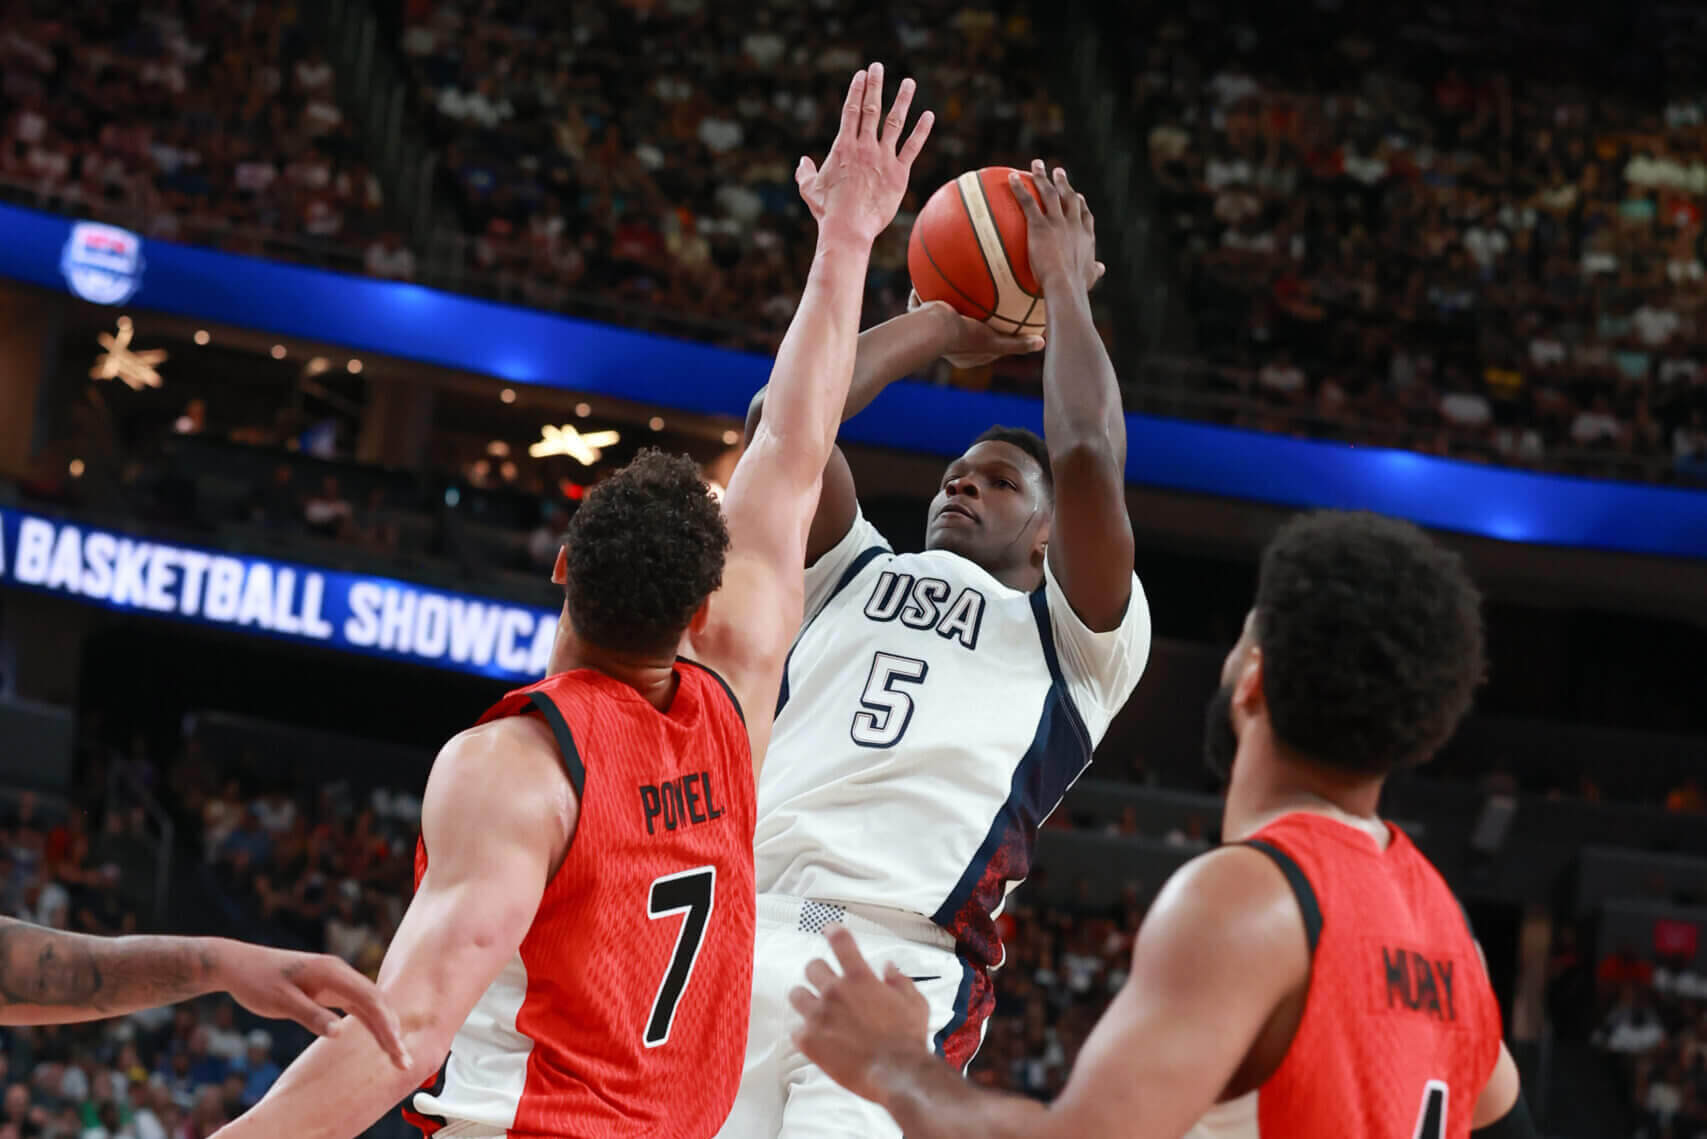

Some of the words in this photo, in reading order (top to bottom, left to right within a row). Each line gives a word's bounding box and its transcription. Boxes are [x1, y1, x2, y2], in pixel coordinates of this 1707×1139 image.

[15, 517, 332, 637] BASKETBALL
[864, 571, 986, 650] USA
[850, 651, 929, 749] 5
[639, 771, 725, 835] POEL
[642, 865, 717, 1048] 7
